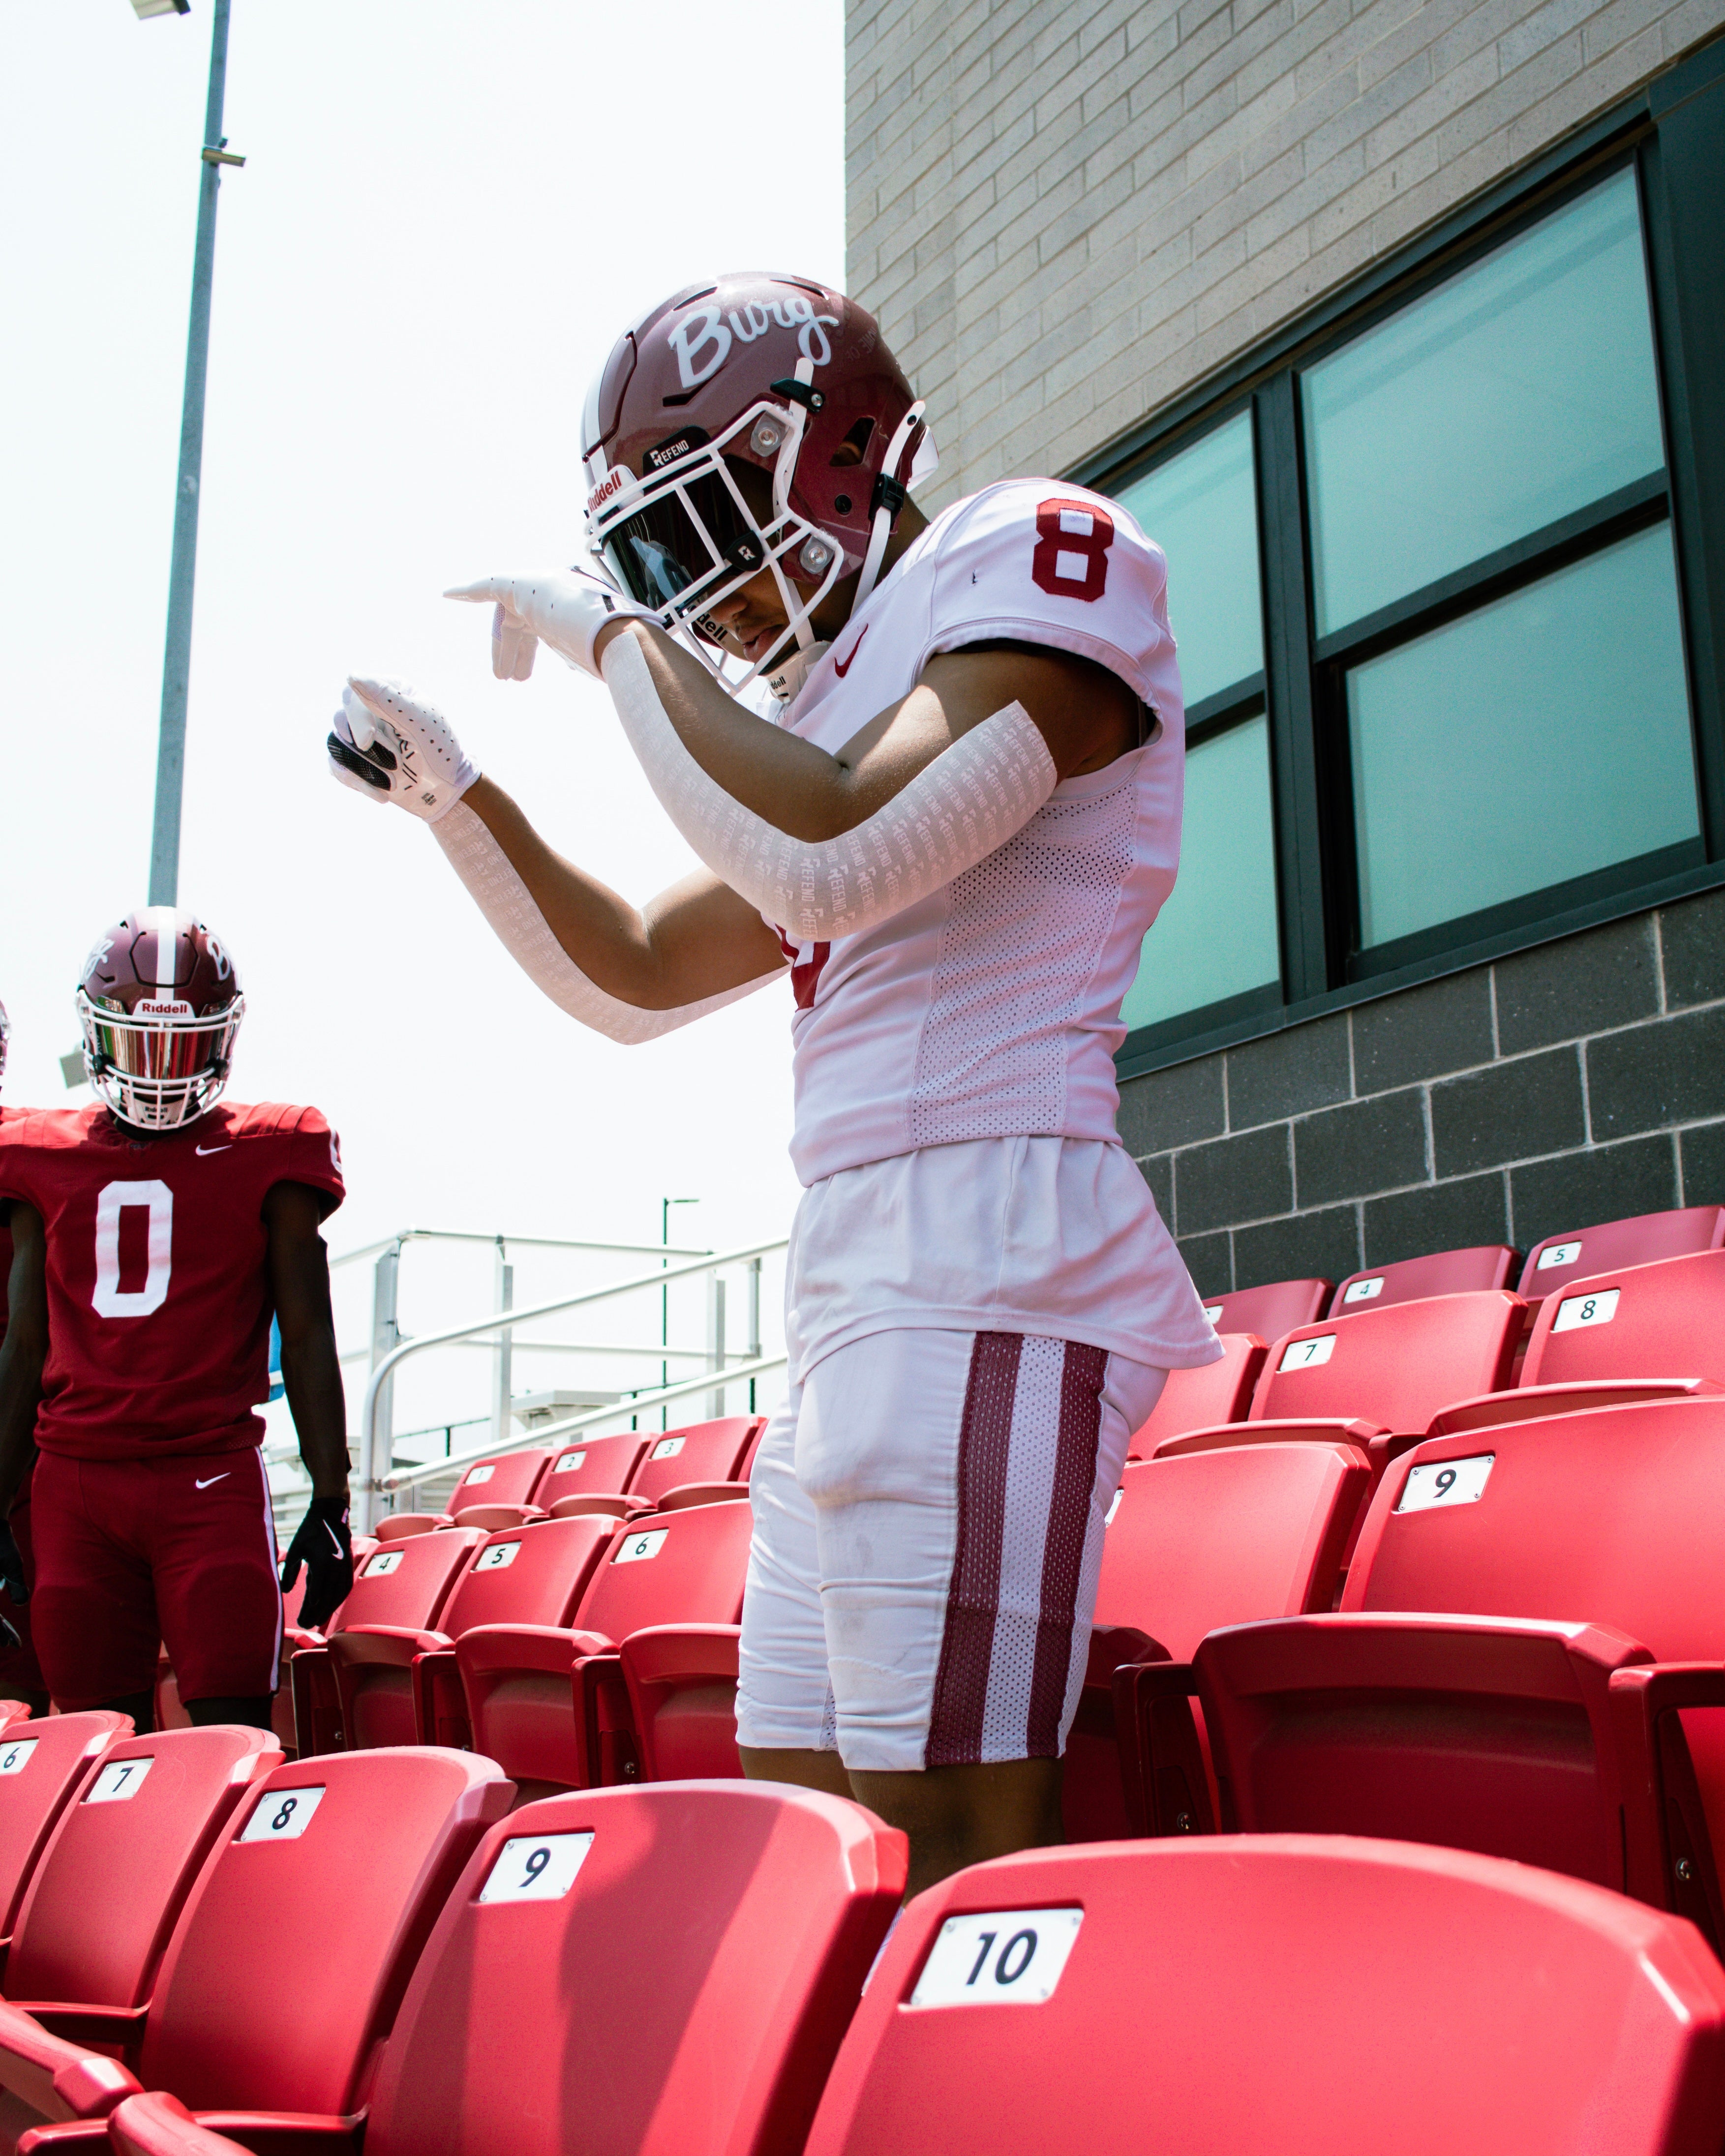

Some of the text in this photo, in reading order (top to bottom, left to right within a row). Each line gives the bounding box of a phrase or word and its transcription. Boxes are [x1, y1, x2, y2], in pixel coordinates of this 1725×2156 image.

[667, 297, 839, 389] Burg
[649, 439, 690, 467] REFEND
[1032, 498, 1115, 603] 8
[696, 613, 728, 641] dell
[770, 676, 786, 689] ddell
[1002, 727, 1030, 766] REFEND
[961, 765, 988, 808] REFEND
[984, 764, 1008, 806] REFEND
[867, 820, 892, 868] REFEND
[892, 818, 916, 865] REFEND
[915, 815, 938, 861] REFEND
[800, 857, 821, 901] REFEND
[828, 863, 849, 913] REFEND
[142, 1002, 187, 1014] Riddell
[91, 1179, 174, 1318] 0
[1554, 1249, 1565, 1262] 5
[1360, 1284, 1370, 1295] 4
[1580, 1300, 1596, 1320] 8
[1305, 1344, 1317, 1361] 7
[567, 1457, 575, 1467] 2
[664, 1442, 673, 1454] 3
[1433, 1469, 1456, 1498] 9
[492, 1548, 506, 1564] 5
[635, 1537, 649, 1555] 6
[379, 1557, 391, 1570] 4
[3, 1747, 20, 1768] 6
[112, 1767, 134, 1792] 7
[272, 1797, 298, 1830] 8
[519, 1847, 551, 1887] 9
[966, 1929, 1038, 1985] 10
